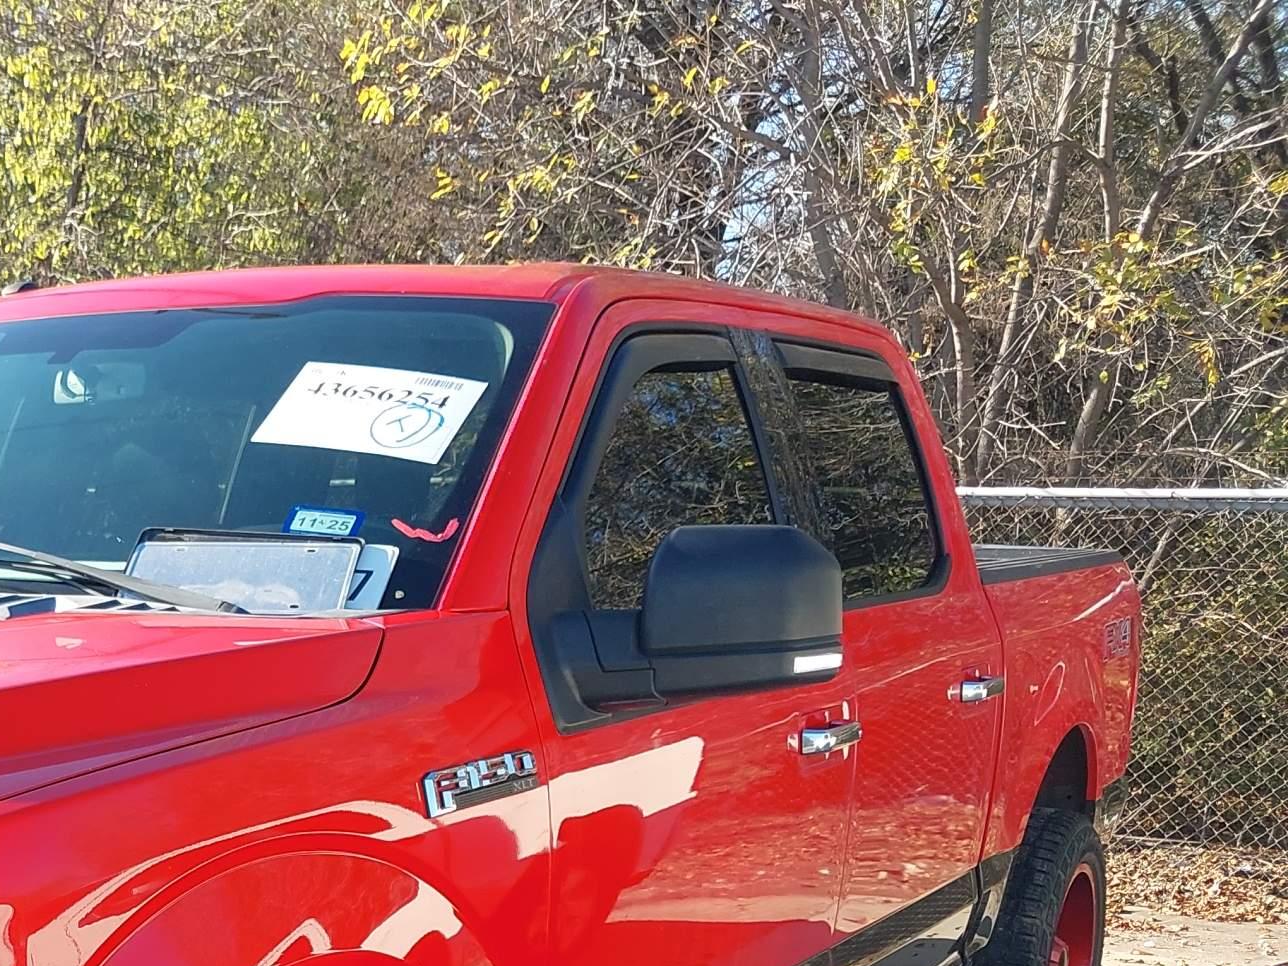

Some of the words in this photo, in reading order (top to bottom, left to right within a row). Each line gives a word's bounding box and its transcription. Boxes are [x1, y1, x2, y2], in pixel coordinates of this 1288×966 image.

[308, 381, 451, 409] 43656254
[298, 516, 318, 528] 11
[325, 519, 352, 531] 25
[347, 569, 374, 601] 7
[511, 777, 536, 793] XLT
